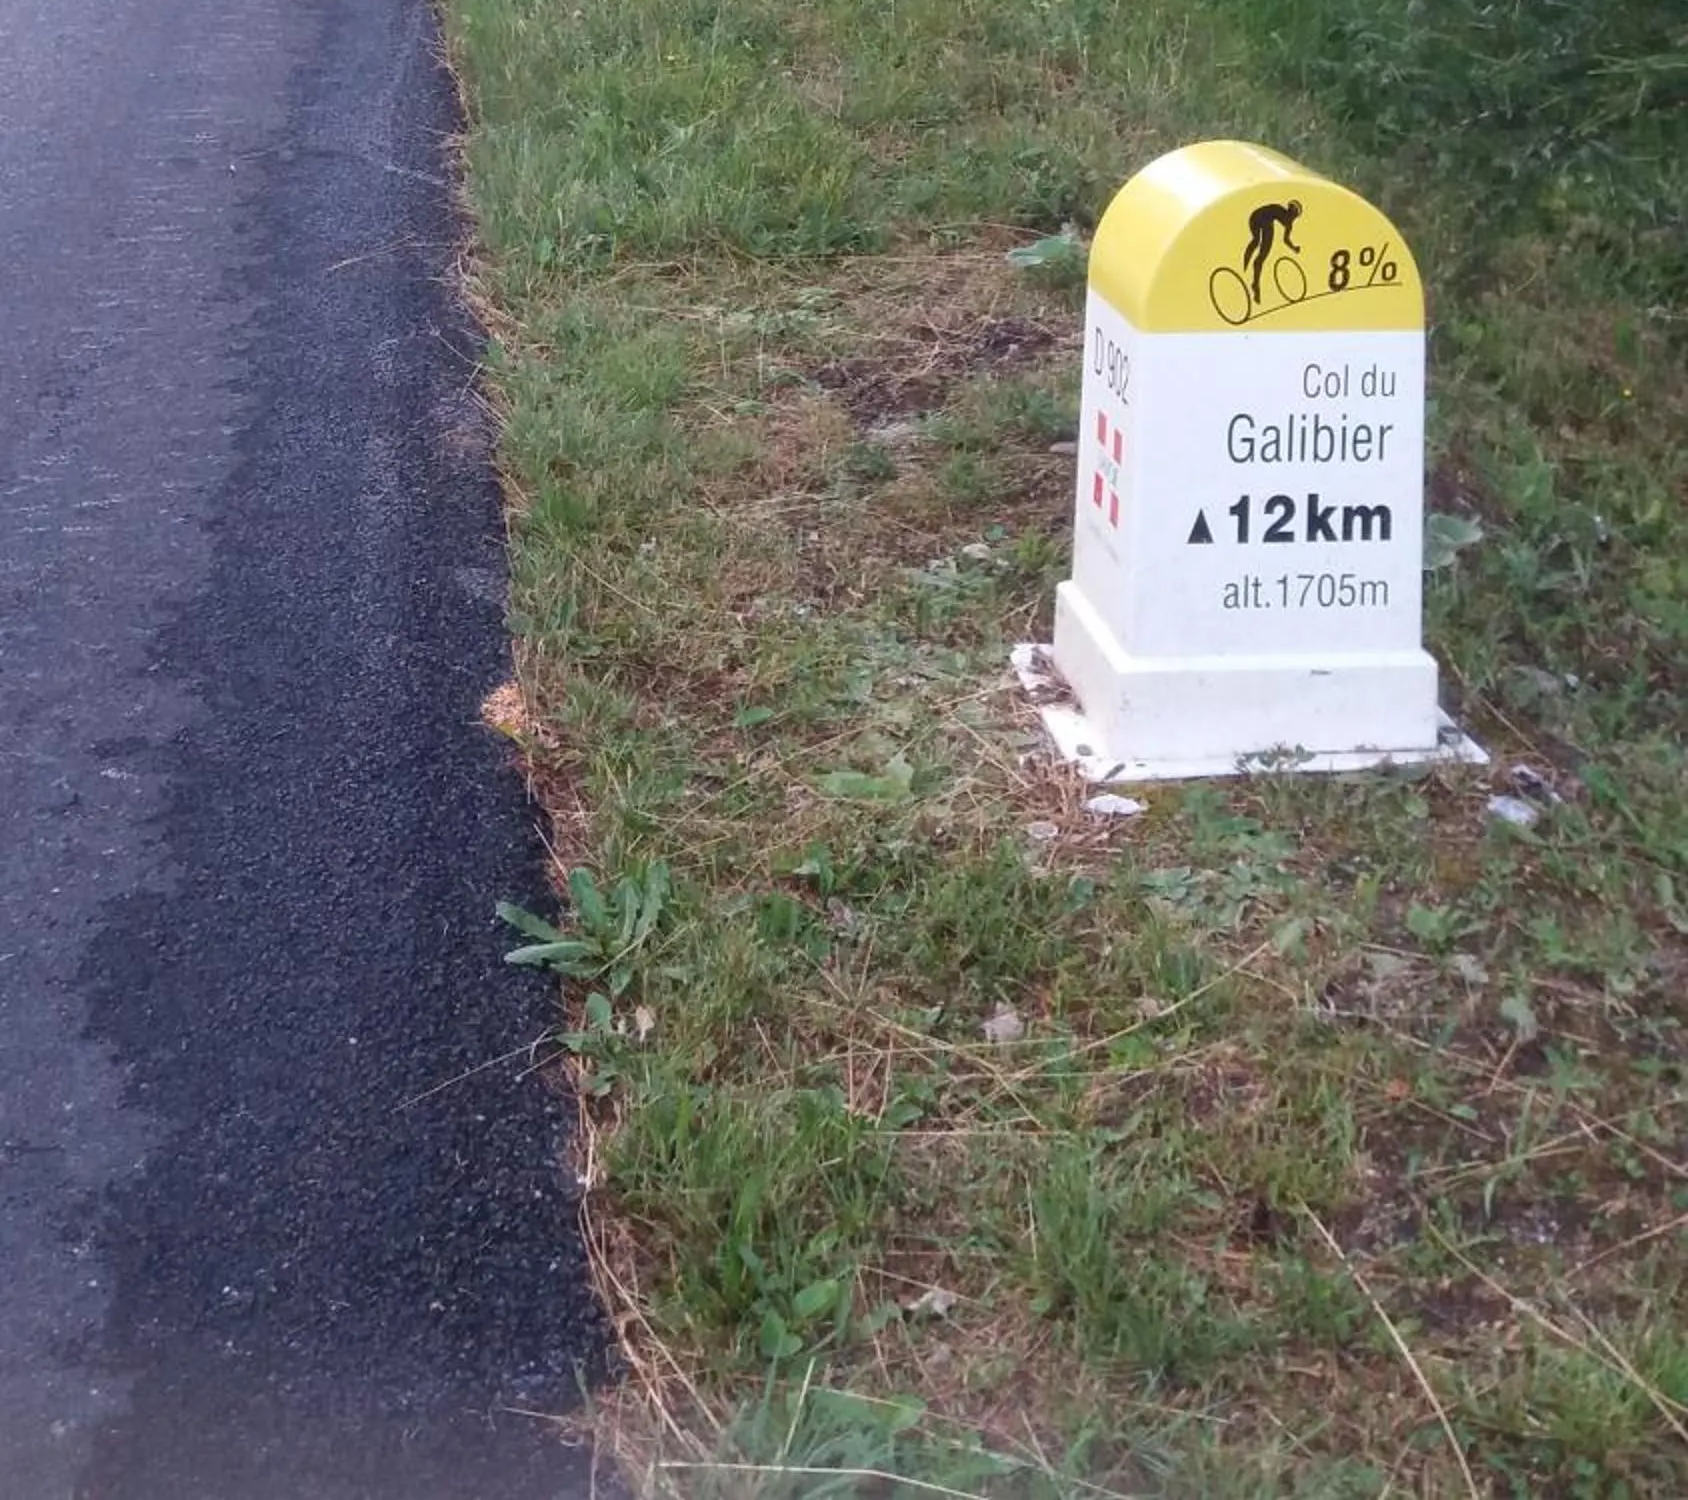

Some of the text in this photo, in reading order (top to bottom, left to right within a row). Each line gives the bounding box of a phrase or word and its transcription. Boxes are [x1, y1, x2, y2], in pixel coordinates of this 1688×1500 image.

[1326, 242, 1398, 293] 8%
[1095, 325, 1130, 406] D 902
[1302, 363, 1397, 399] Col du
[1226, 413, 1395, 465] Galibier
[1228, 492, 1393, 545] 12km
[1222, 573, 1390, 610] alt.1705m
